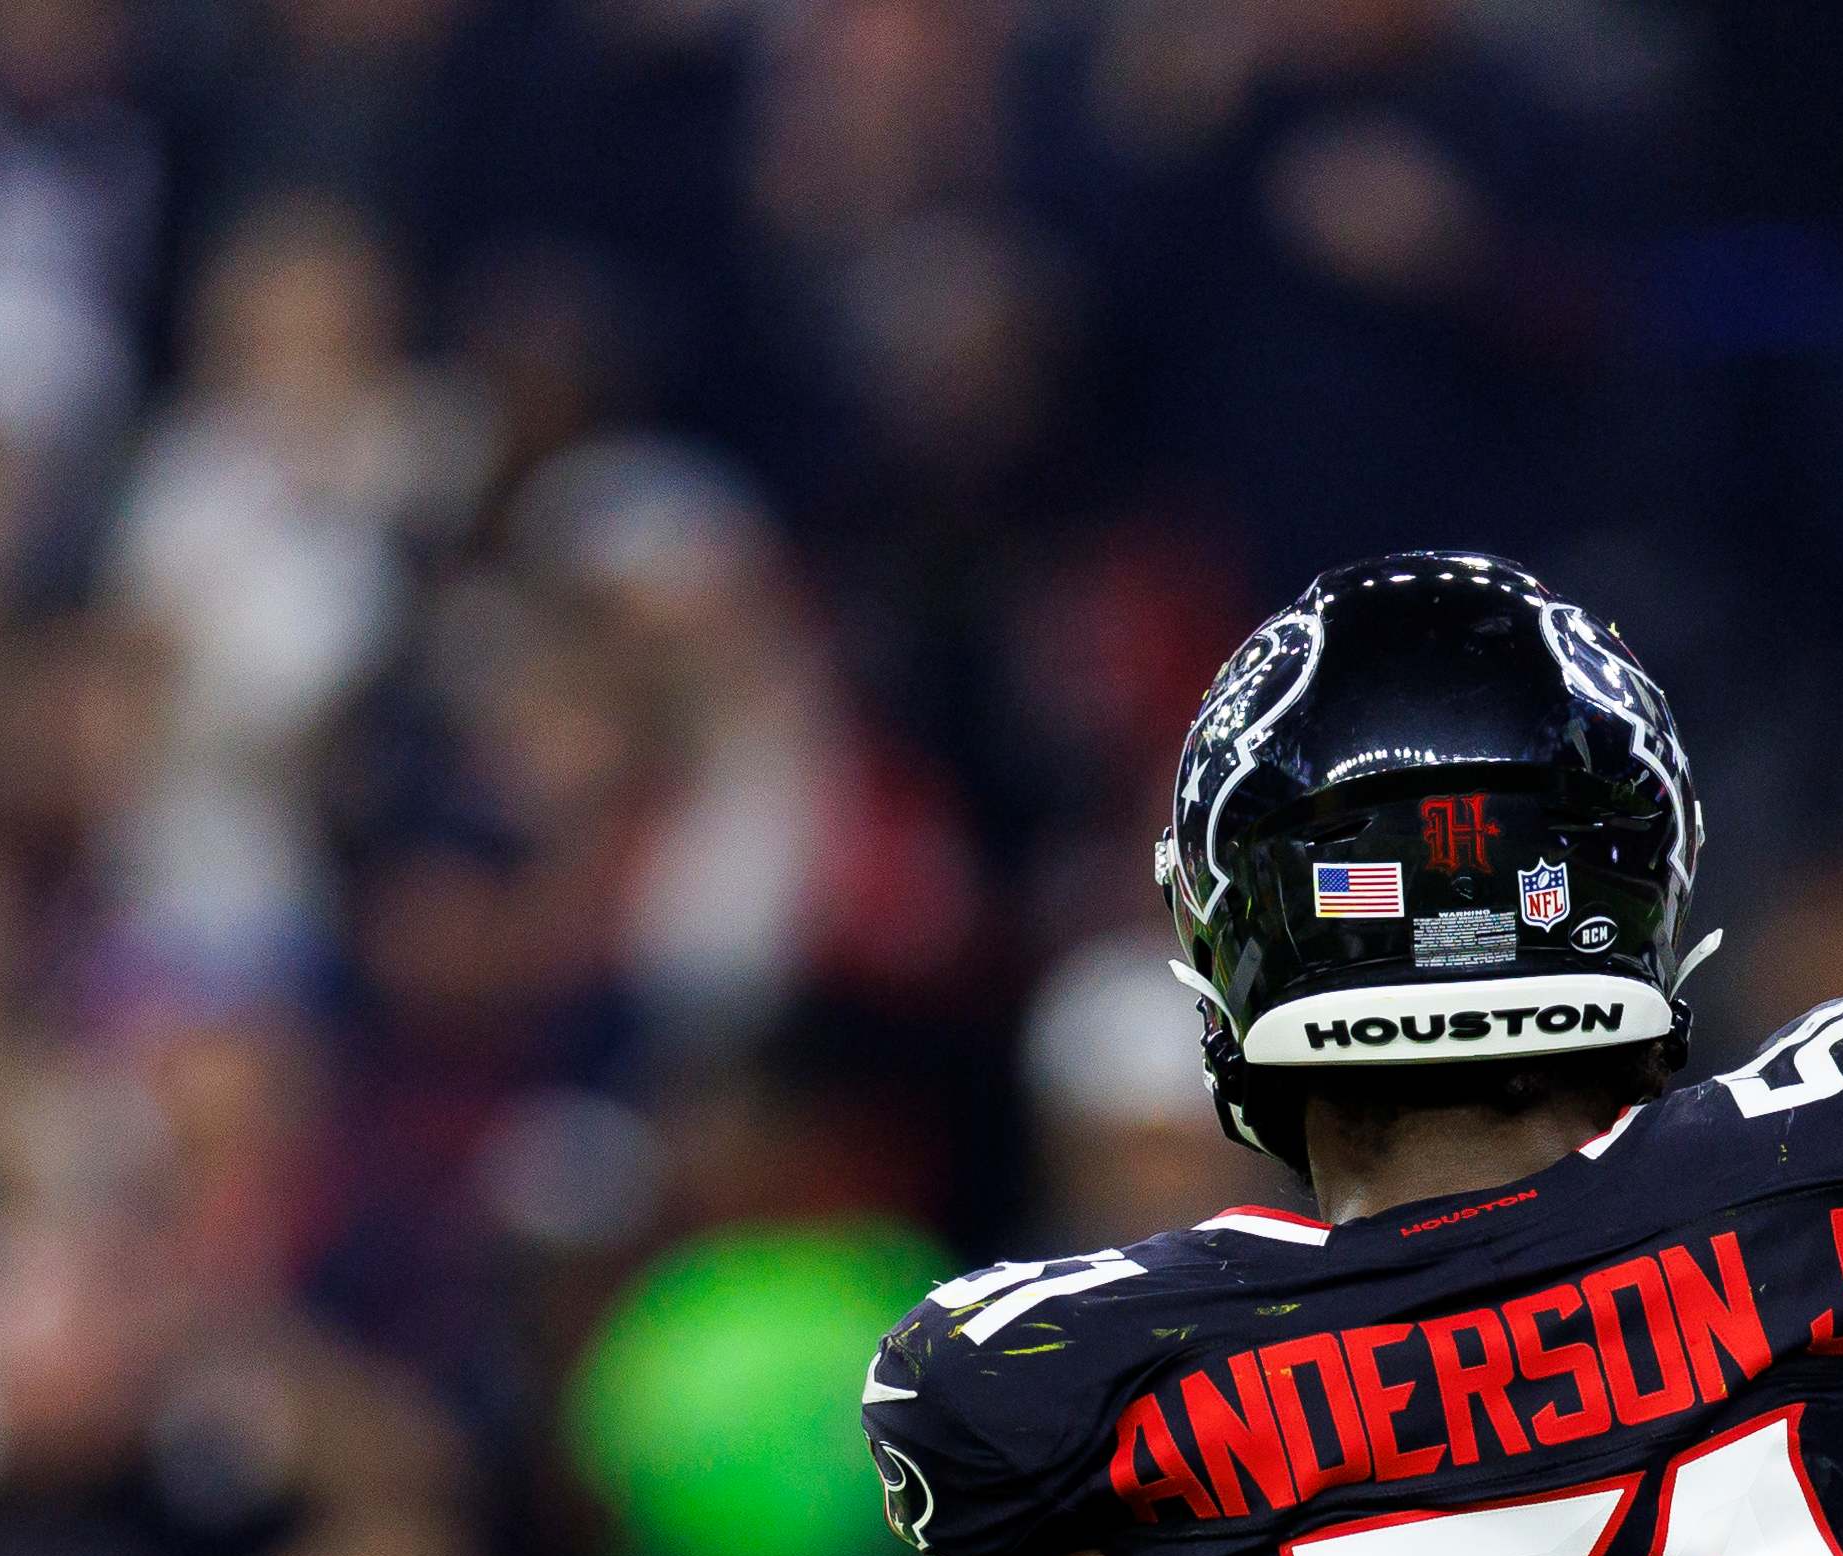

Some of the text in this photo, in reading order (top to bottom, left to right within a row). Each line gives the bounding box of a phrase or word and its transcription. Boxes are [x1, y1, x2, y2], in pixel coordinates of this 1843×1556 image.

[1438, 909, 1491, 918] WARNING
[1527, 890, 1564, 918] NFL
[1304, 1003, 1625, 1049] HOUSTON
[1400, 1188, 1539, 1238] HOUSTON
[1109, 1231, 1773, 1523] ANDERSON
